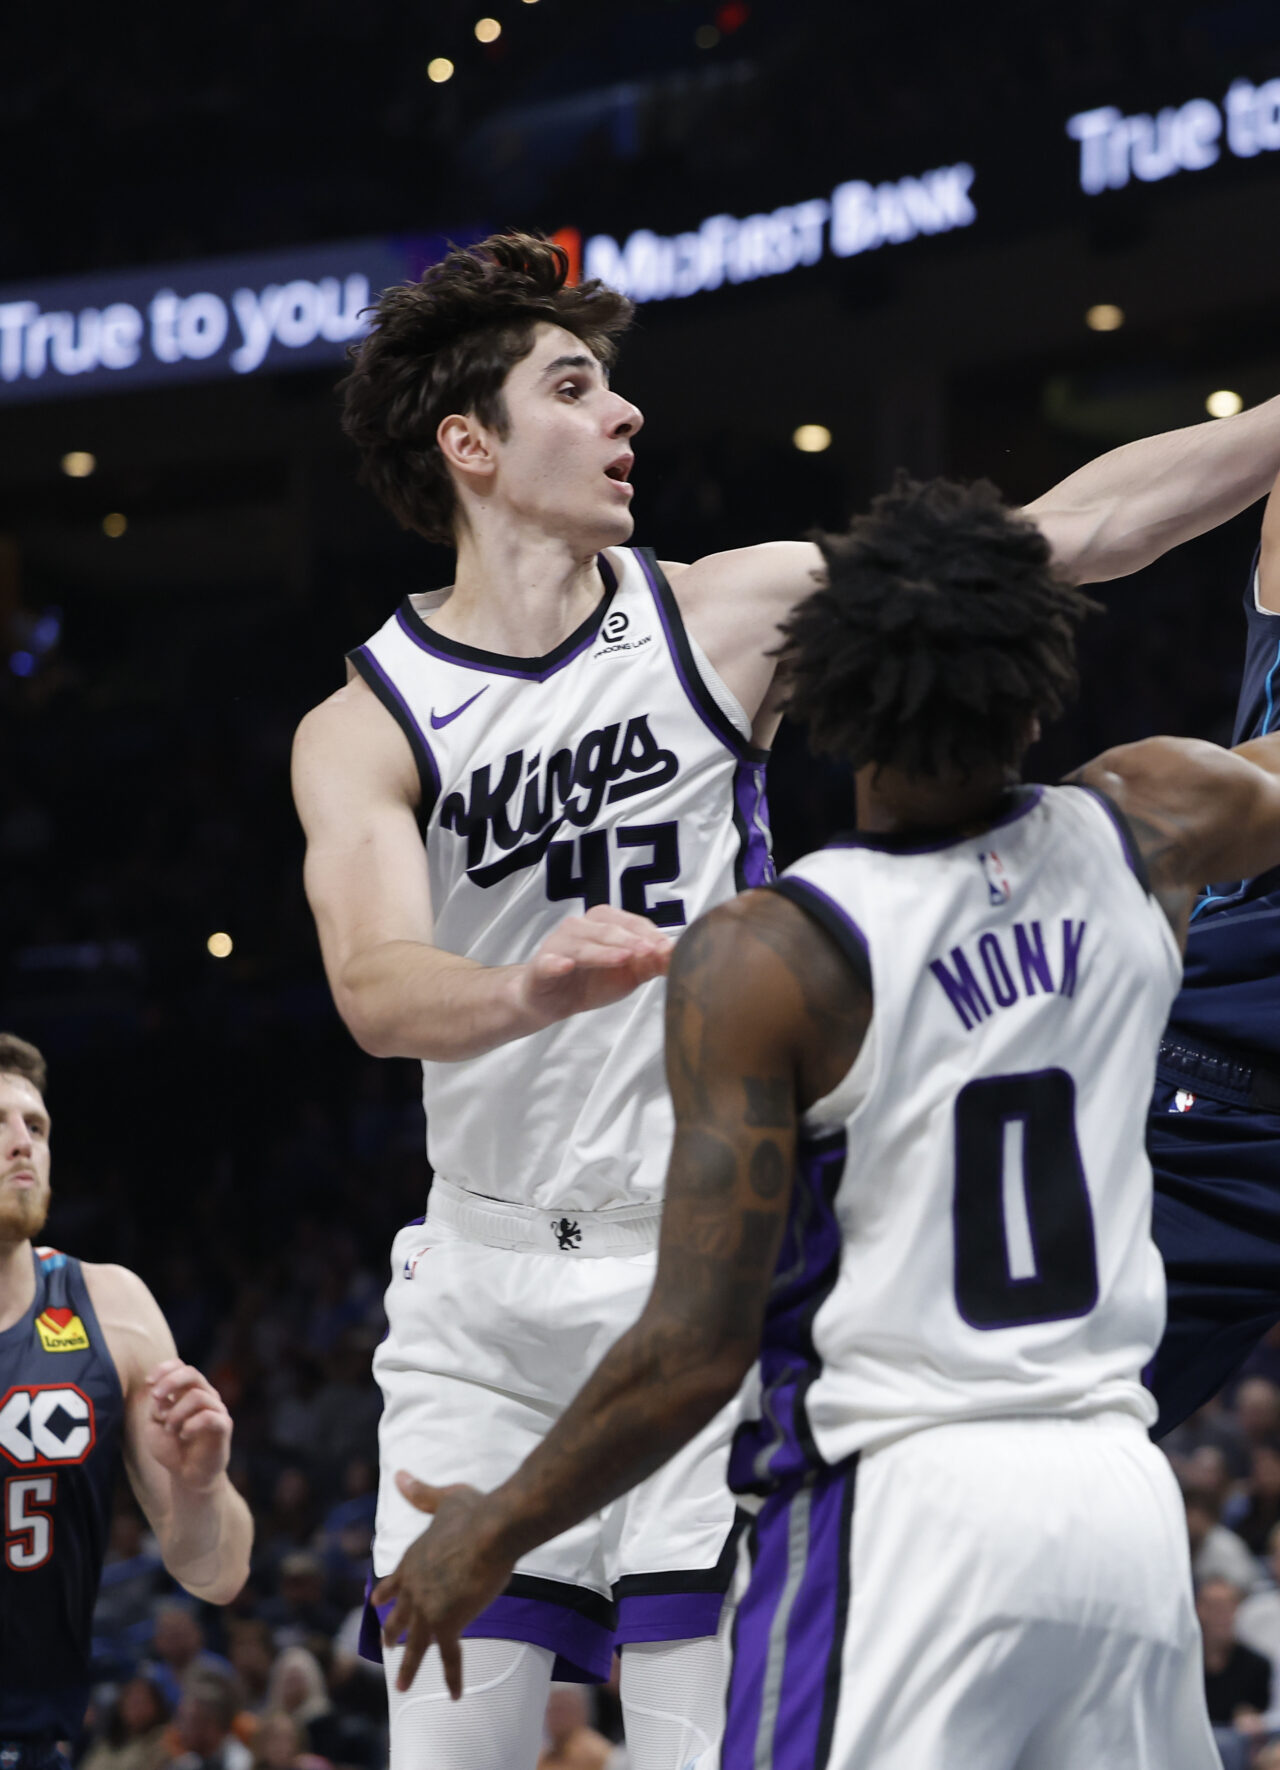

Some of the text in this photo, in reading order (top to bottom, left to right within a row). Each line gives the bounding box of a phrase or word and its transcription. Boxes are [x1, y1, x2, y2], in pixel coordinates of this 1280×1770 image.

[1066, 97, 1222, 196] True
[0, 301, 144, 382] True
[149, 288, 230, 363] to
[440, 714, 680, 890] Kings
[546, 820, 687, 928] 42
[929, 919, 1086, 1032] MONK
[953, 1066, 1101, 1332] 0
[5, 1472, 57, 1571] 5
